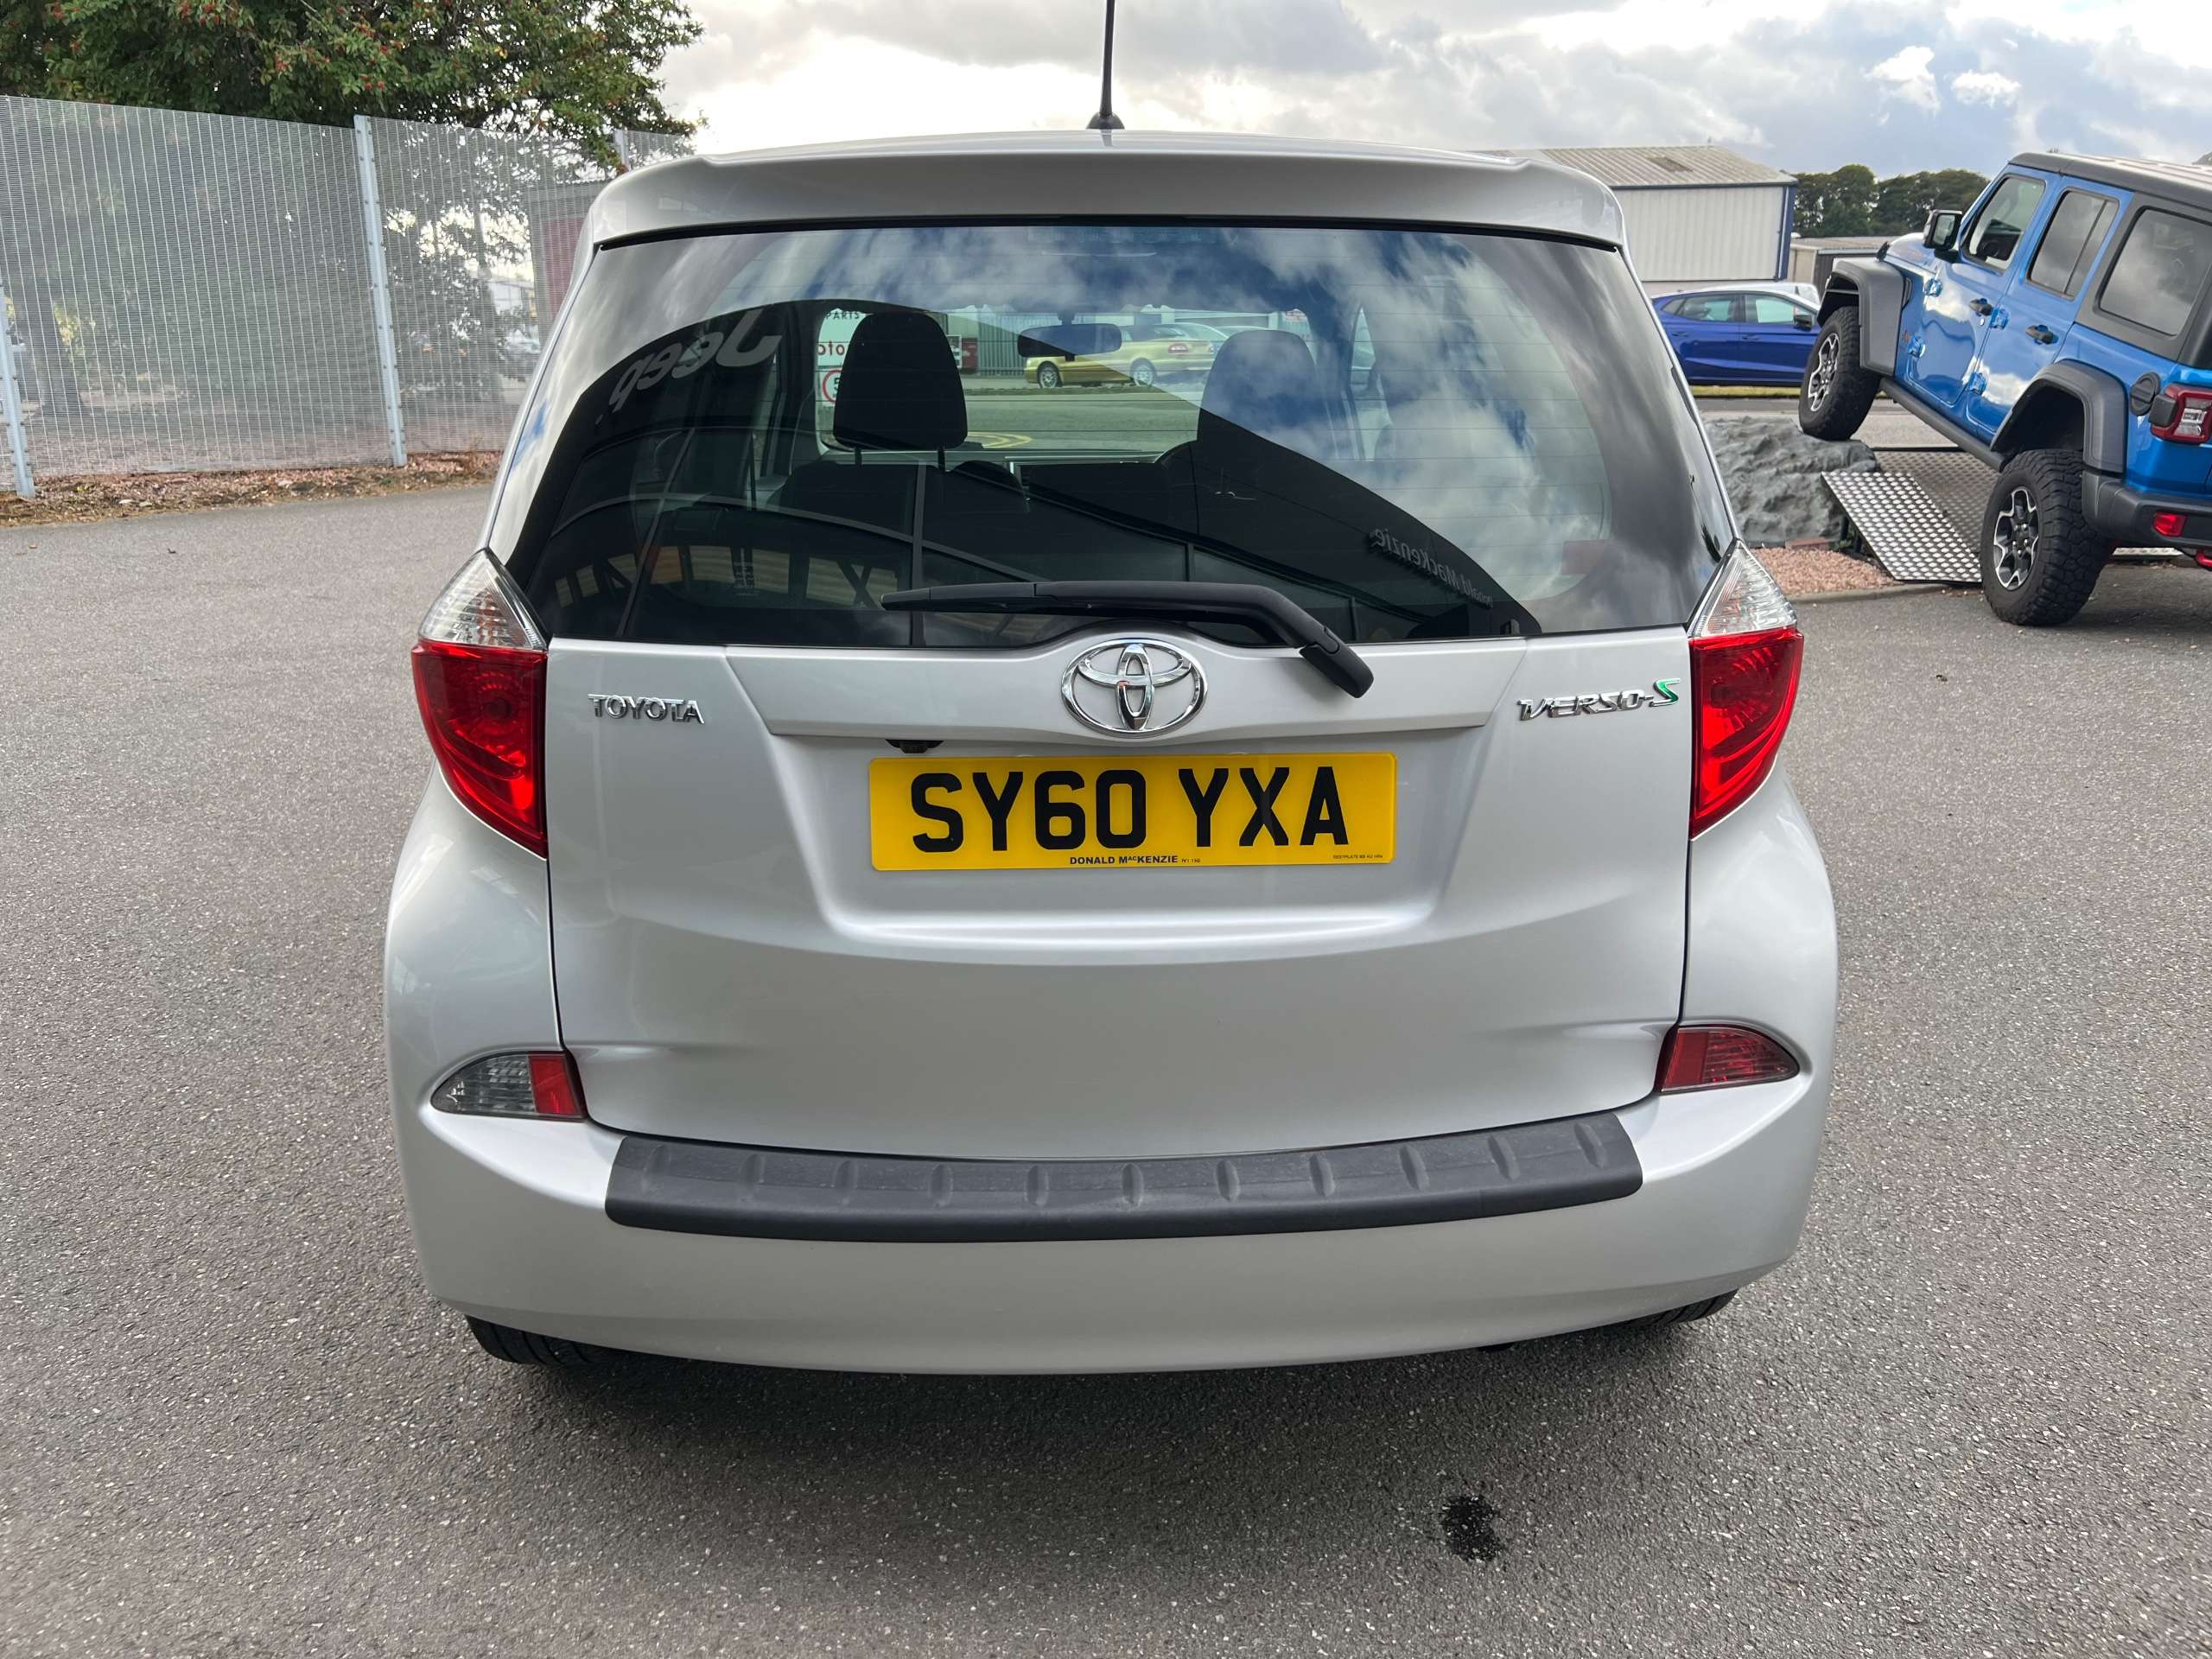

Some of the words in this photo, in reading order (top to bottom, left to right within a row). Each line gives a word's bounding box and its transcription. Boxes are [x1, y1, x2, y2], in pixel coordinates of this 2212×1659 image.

[588, 694, 704, 724] TOYOTA
[1516, 678, 1681, 721] VERSO-S
[911, 770, 1147, 853] SY60
[1178, 766, 1349, 848] YXA
[1070, 856, 1116, 865] DONALD
